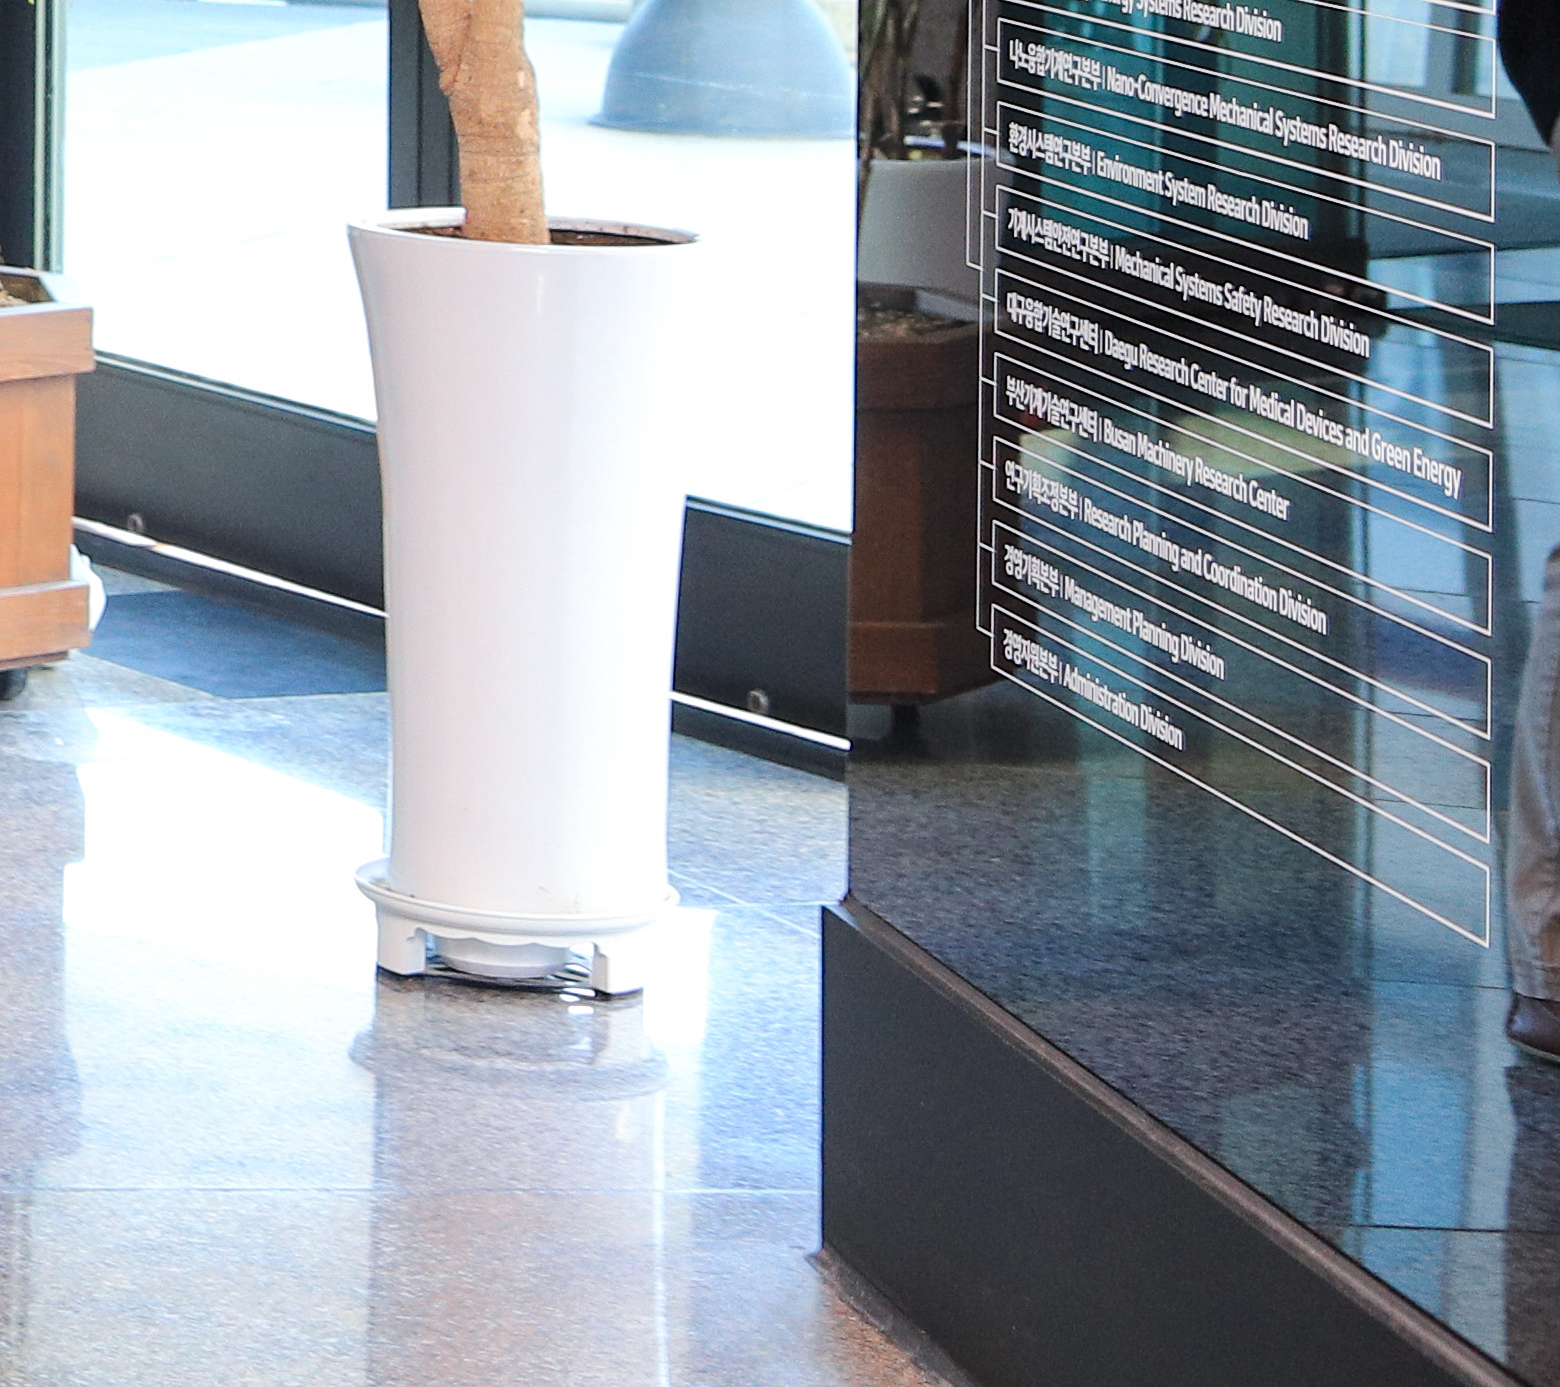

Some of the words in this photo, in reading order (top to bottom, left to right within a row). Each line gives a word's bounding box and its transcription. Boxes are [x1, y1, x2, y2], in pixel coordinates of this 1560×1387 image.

[1106, 66, 1210, 117] Nano-Convergence
[1208, 92, 1275, 135] Mechanical
[1274, 109, 1328, 150] Systems
[1327, 123, 1388, 166] Research
[1388, 139, 1441, 181] Division
[1114, 244, 1175, 290] Mechanical
[1174, 265, 1224, 306] Systems
[1223, 282, 1263, 327] Safety
[1262, 295, 1320, 341] Research
[1320, 314, 1370, 358] Division
[1104, 327, 1140, 376] Daegu
[1138, 339, 1190, 388] Research
[1189, 360, 1230, 404] Center
[1228, 374, 1250, 411] for
[1248, 382, 1296, 430] Medical
[1296, 399, 1345, 449] Devices
[1344, 418, 1371, 459] and
[1371, 430, 1412, 476] Green
[1412, 445, 1462, 503] Energy
[1083, 494, 1132, 545] Research
[1131, 516, 1180, 575] Planning
[1179, 539, 1203, 579] and
[1202, 549, 1279, 616] Coordination
[1278, 584, 1328, 638] Division
[1062, 663, 1140, 727] Administration
[1139, 703, 1183, 751] Division
